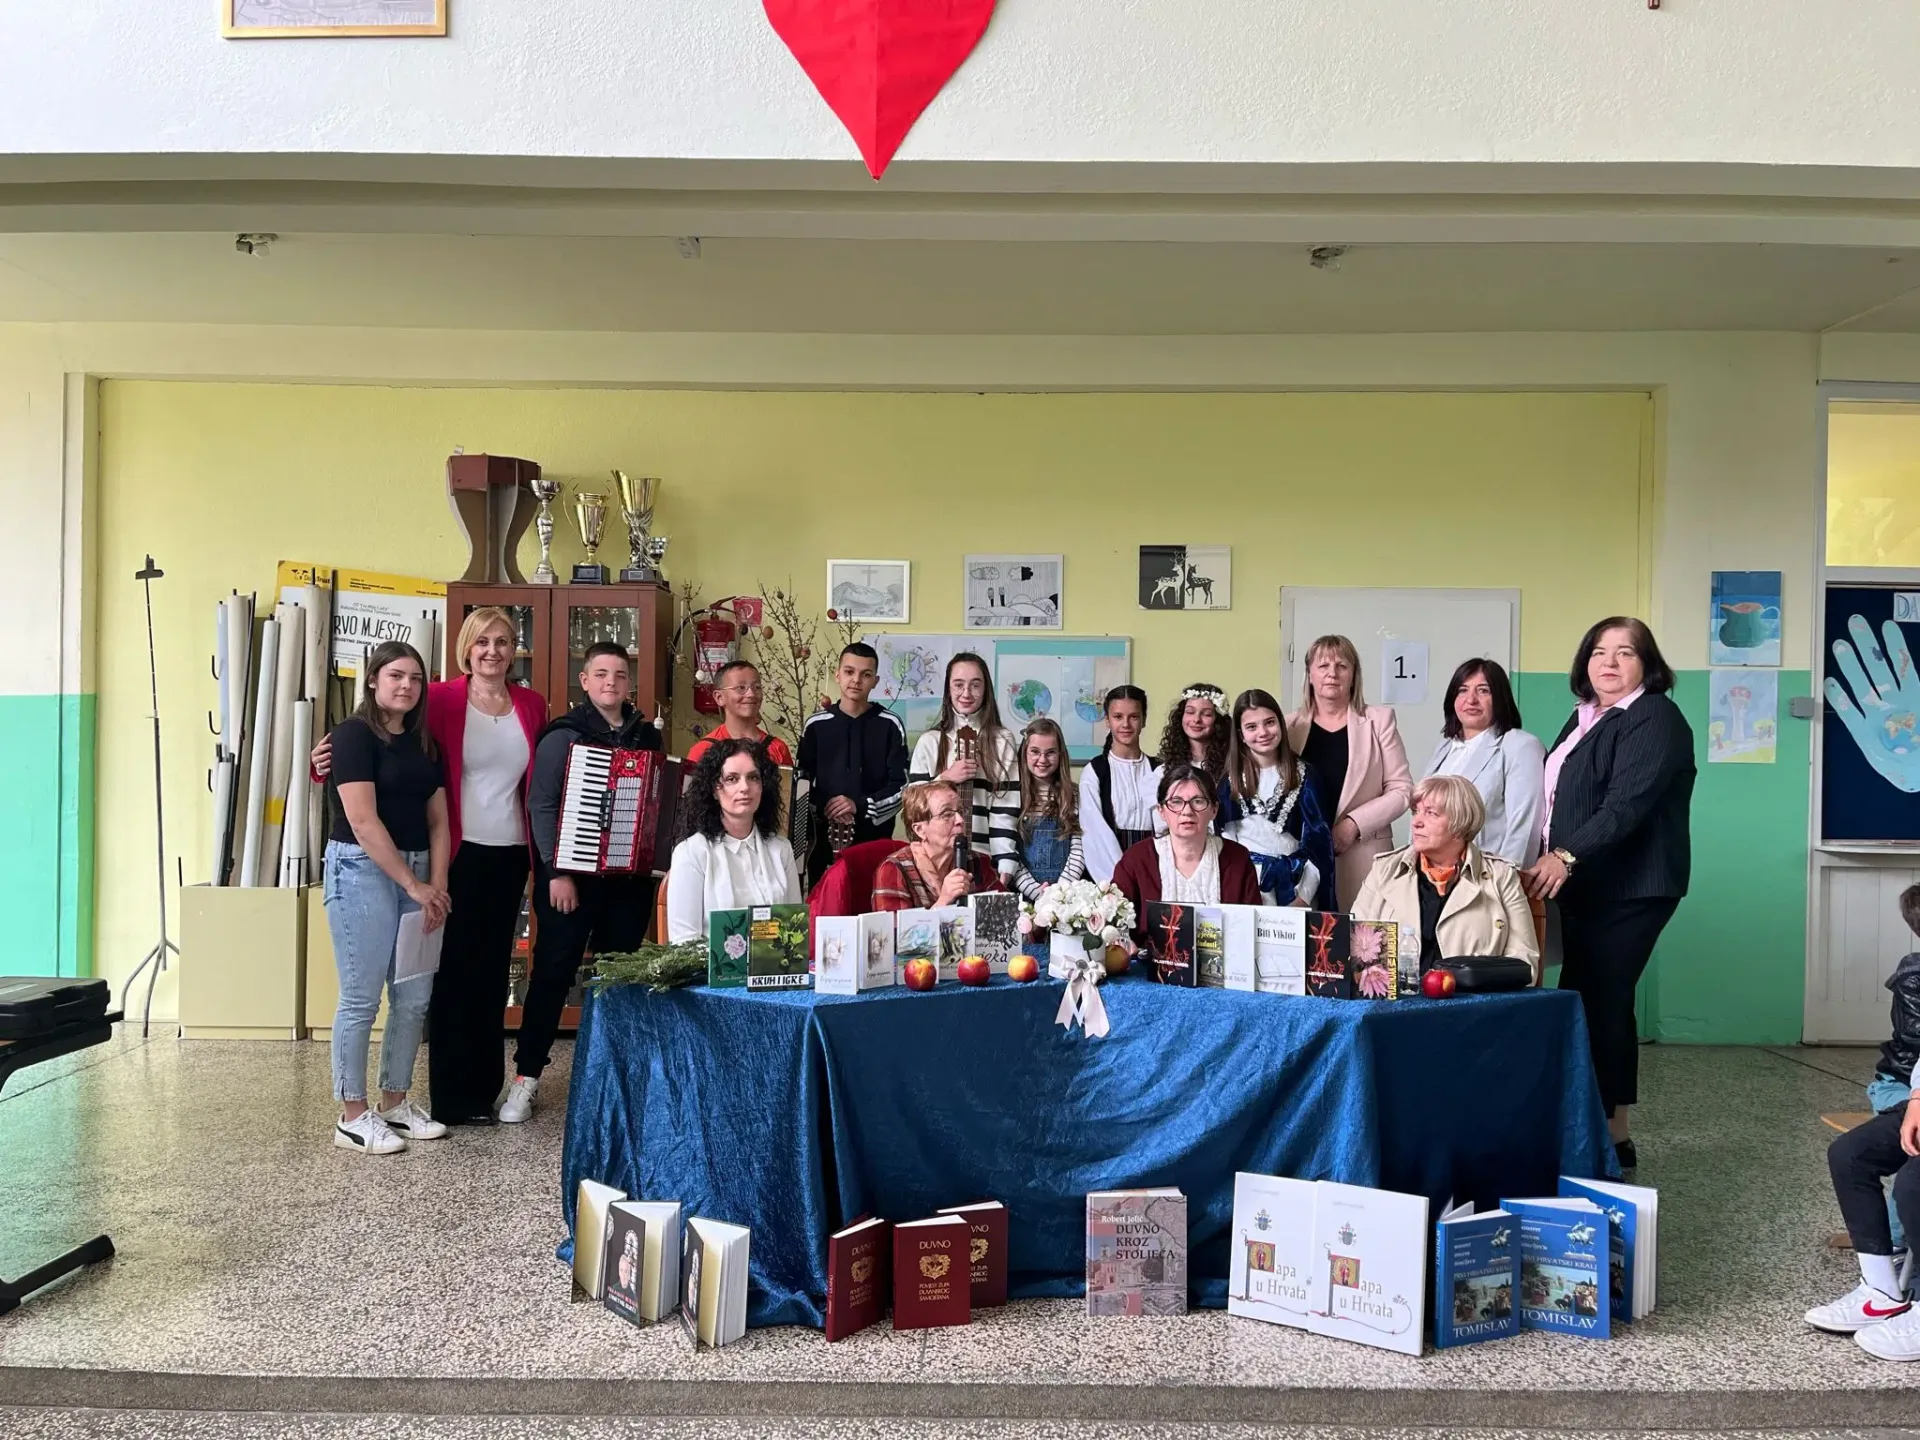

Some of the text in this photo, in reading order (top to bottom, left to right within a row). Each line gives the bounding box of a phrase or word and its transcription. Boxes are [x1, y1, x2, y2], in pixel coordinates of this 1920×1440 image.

[333, 615, 411, 643] RVO MJESTO
[1394, 656, 1417, 680] 1.
[1273, 929, 1296, 941] Viktor
[752, 975, 776, 986] KRUH
[783, 974, 804, 985] IGRE
[1101, 1215, 1126, 1223] Robert
[970, 1224, 989, 1233] VNO
[1116, 1224, 1160, 1234] DUVNO
[919, 1240, 951, 1250] DUVNO
[1116, 1237, 1149, 1247] KROZ
[1536, 1254, 1573, 1267] HRVATSKI
[1574, 1261, 1597, 1271] KRALJ
[1256, 1279, 1307, 1300] u Hrvata
[1340, 1295, 1393, 1318] u Hrvata
[1520, 1308, 1598, 1330] TOMISLAV
[1452, 1318, 1512, 1339] TOMISLAV
